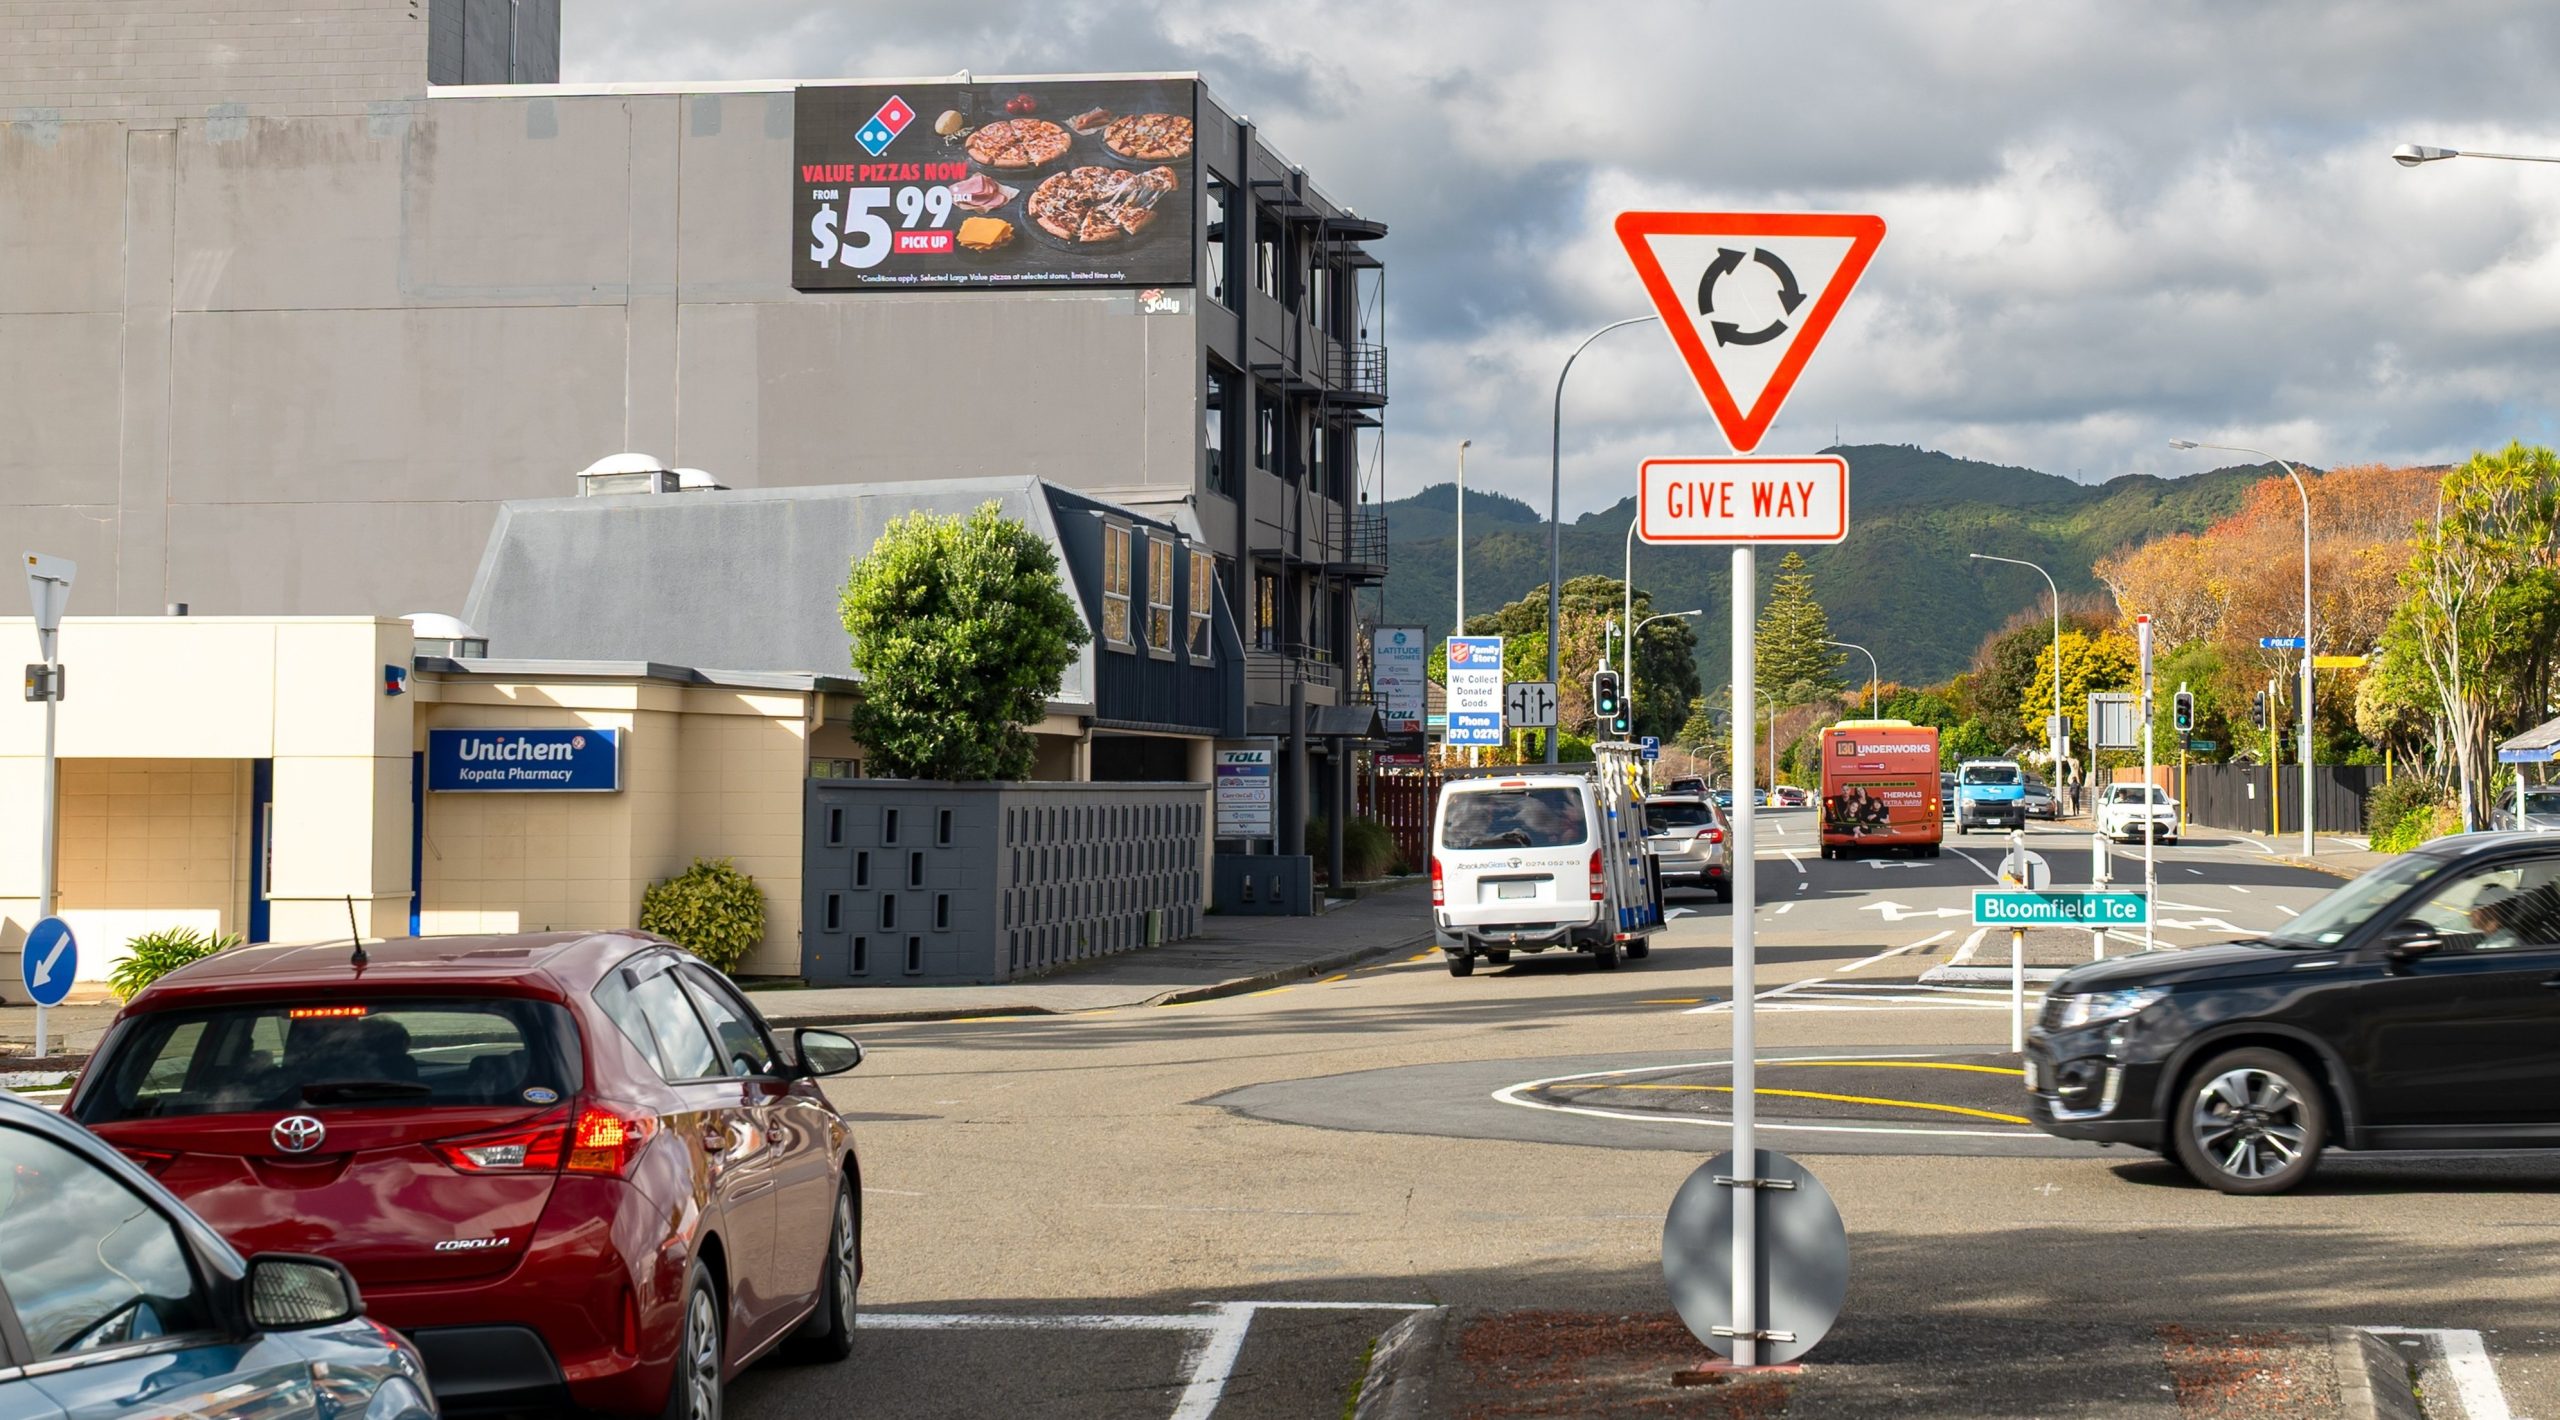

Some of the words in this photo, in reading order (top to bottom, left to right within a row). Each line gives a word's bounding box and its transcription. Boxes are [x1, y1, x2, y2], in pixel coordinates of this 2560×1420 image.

[802, 164, 854, 182] VALUE
[860, 163, 921, 182] PIZZAS
[924, 162, 968, 181] NOW
[813, 189, 839, 200] FROM
[901, 236, 928, 249] PICK
[931, 236, 948, 248] UP
[898, 274, 919, 283] apply.
[920, 273, 949, 281] Selected
[950, 273, 968, 283] Large
[969, 272, 988, 281] Value
[989, 274, 1011, 282] pizzas
[1021, 272, 1048, 280] selected
[1049, 273, 1070, 281] stores,
[1071, 271, 1093, 279] limited
[1110, 271, 1126, 281] only.
[1144, 297, 1180, 313] Jolly
[1668, 481, 1734, 519] GIVE
[1751, 481, 1815, 518] WAY
[2270, 638, 2295, 647] POLICE
[1377, 647, 1421, 655] LATITUDE
[1470, 645, 1499, 656] Family
[1472, 654, 1497, 663] Store
[1452, 675, 1465, 683] We
[1468, 674, 1498, 684] Collect
[1457, 687, 1493, 695] Donated
[1461, 699, 1488, 707] Goods
[1458, 715, 1491, 726] Phone
[1450, 728, 1470, 739] 570
[459, 736, 574, 761] Unichem
[1837, 742, 1854, 755] 130
[1857, 744, 1931, 755] UNDERWORKS
[1224, 751, 1264, 762] TOLL
[1379, 755, 1395, 763] 65
[459, 768, 505, 783] Kopata
[508, 767, 573, 782] Pharmacy
[1883, 791, 1922, 799] THERMALS
[1984, 898, 2096, 919] Bloomfield
[2102, 898, 2137, 918] Tce
[434, 1237, 510, 1251] COROLLA
